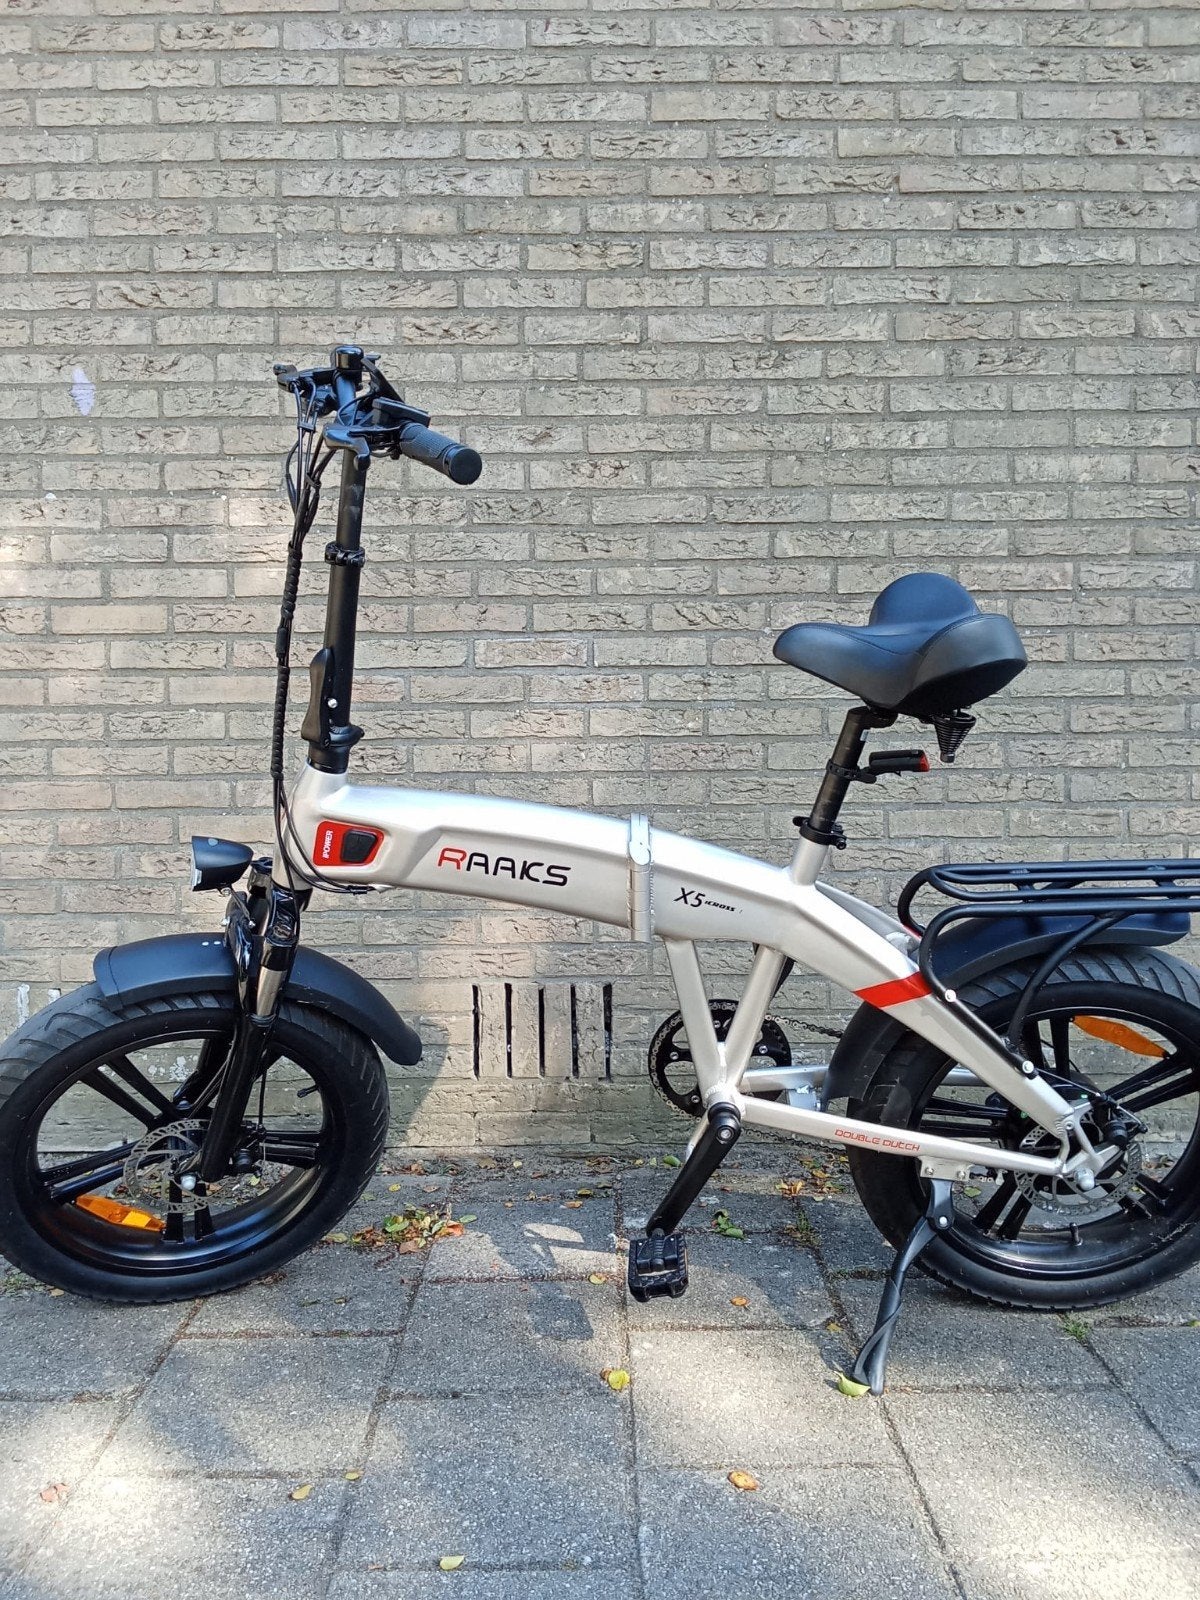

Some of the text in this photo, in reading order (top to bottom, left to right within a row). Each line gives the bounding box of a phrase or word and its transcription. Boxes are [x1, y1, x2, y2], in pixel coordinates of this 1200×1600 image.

[438, 847, 571, 886] RAAKS
[672, 886, 706, 908] X5
[834, 1128, 921, 1152] DOUBLE DUTCH
